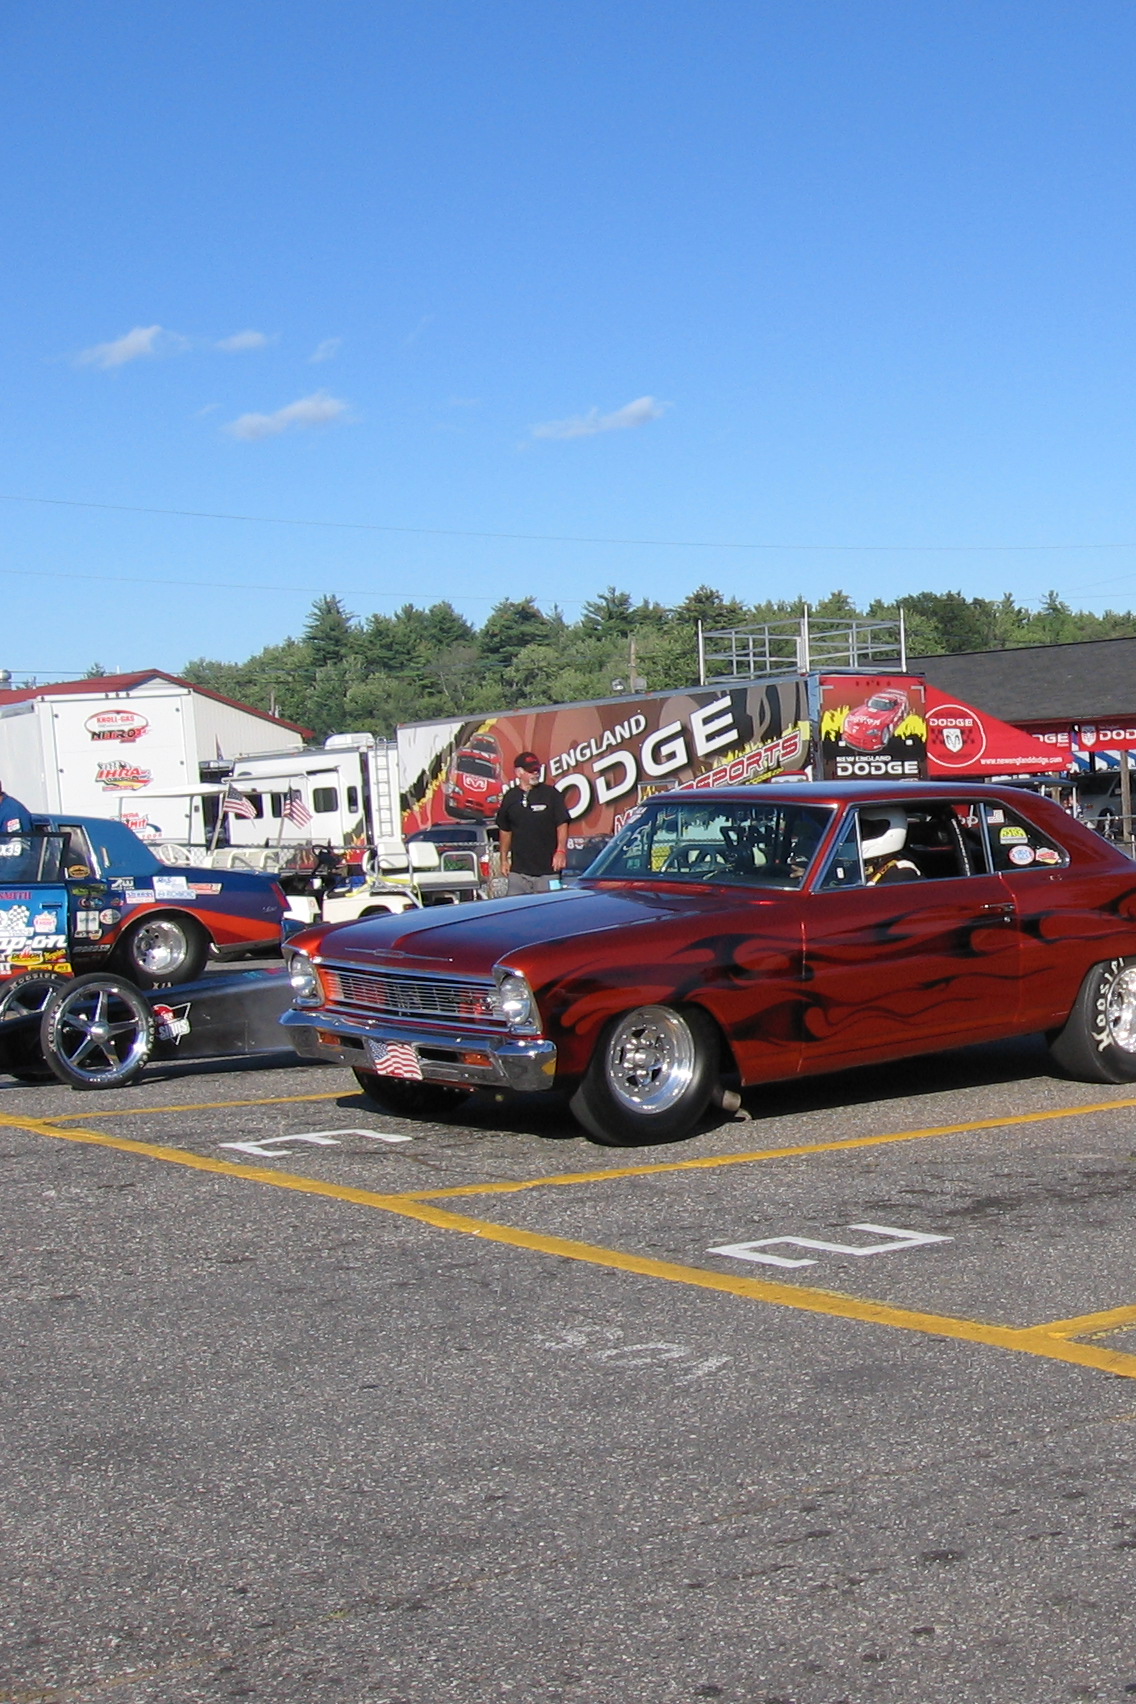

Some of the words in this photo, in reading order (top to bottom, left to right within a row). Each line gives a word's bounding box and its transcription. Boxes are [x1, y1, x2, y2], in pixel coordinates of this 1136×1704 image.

[550, 714, 647, 777] ENGLAND
[555, 695, 739, 819] ODGE
[836, 761, 919, 776] DODGE
[705, 1222, 956, 1270] 2
